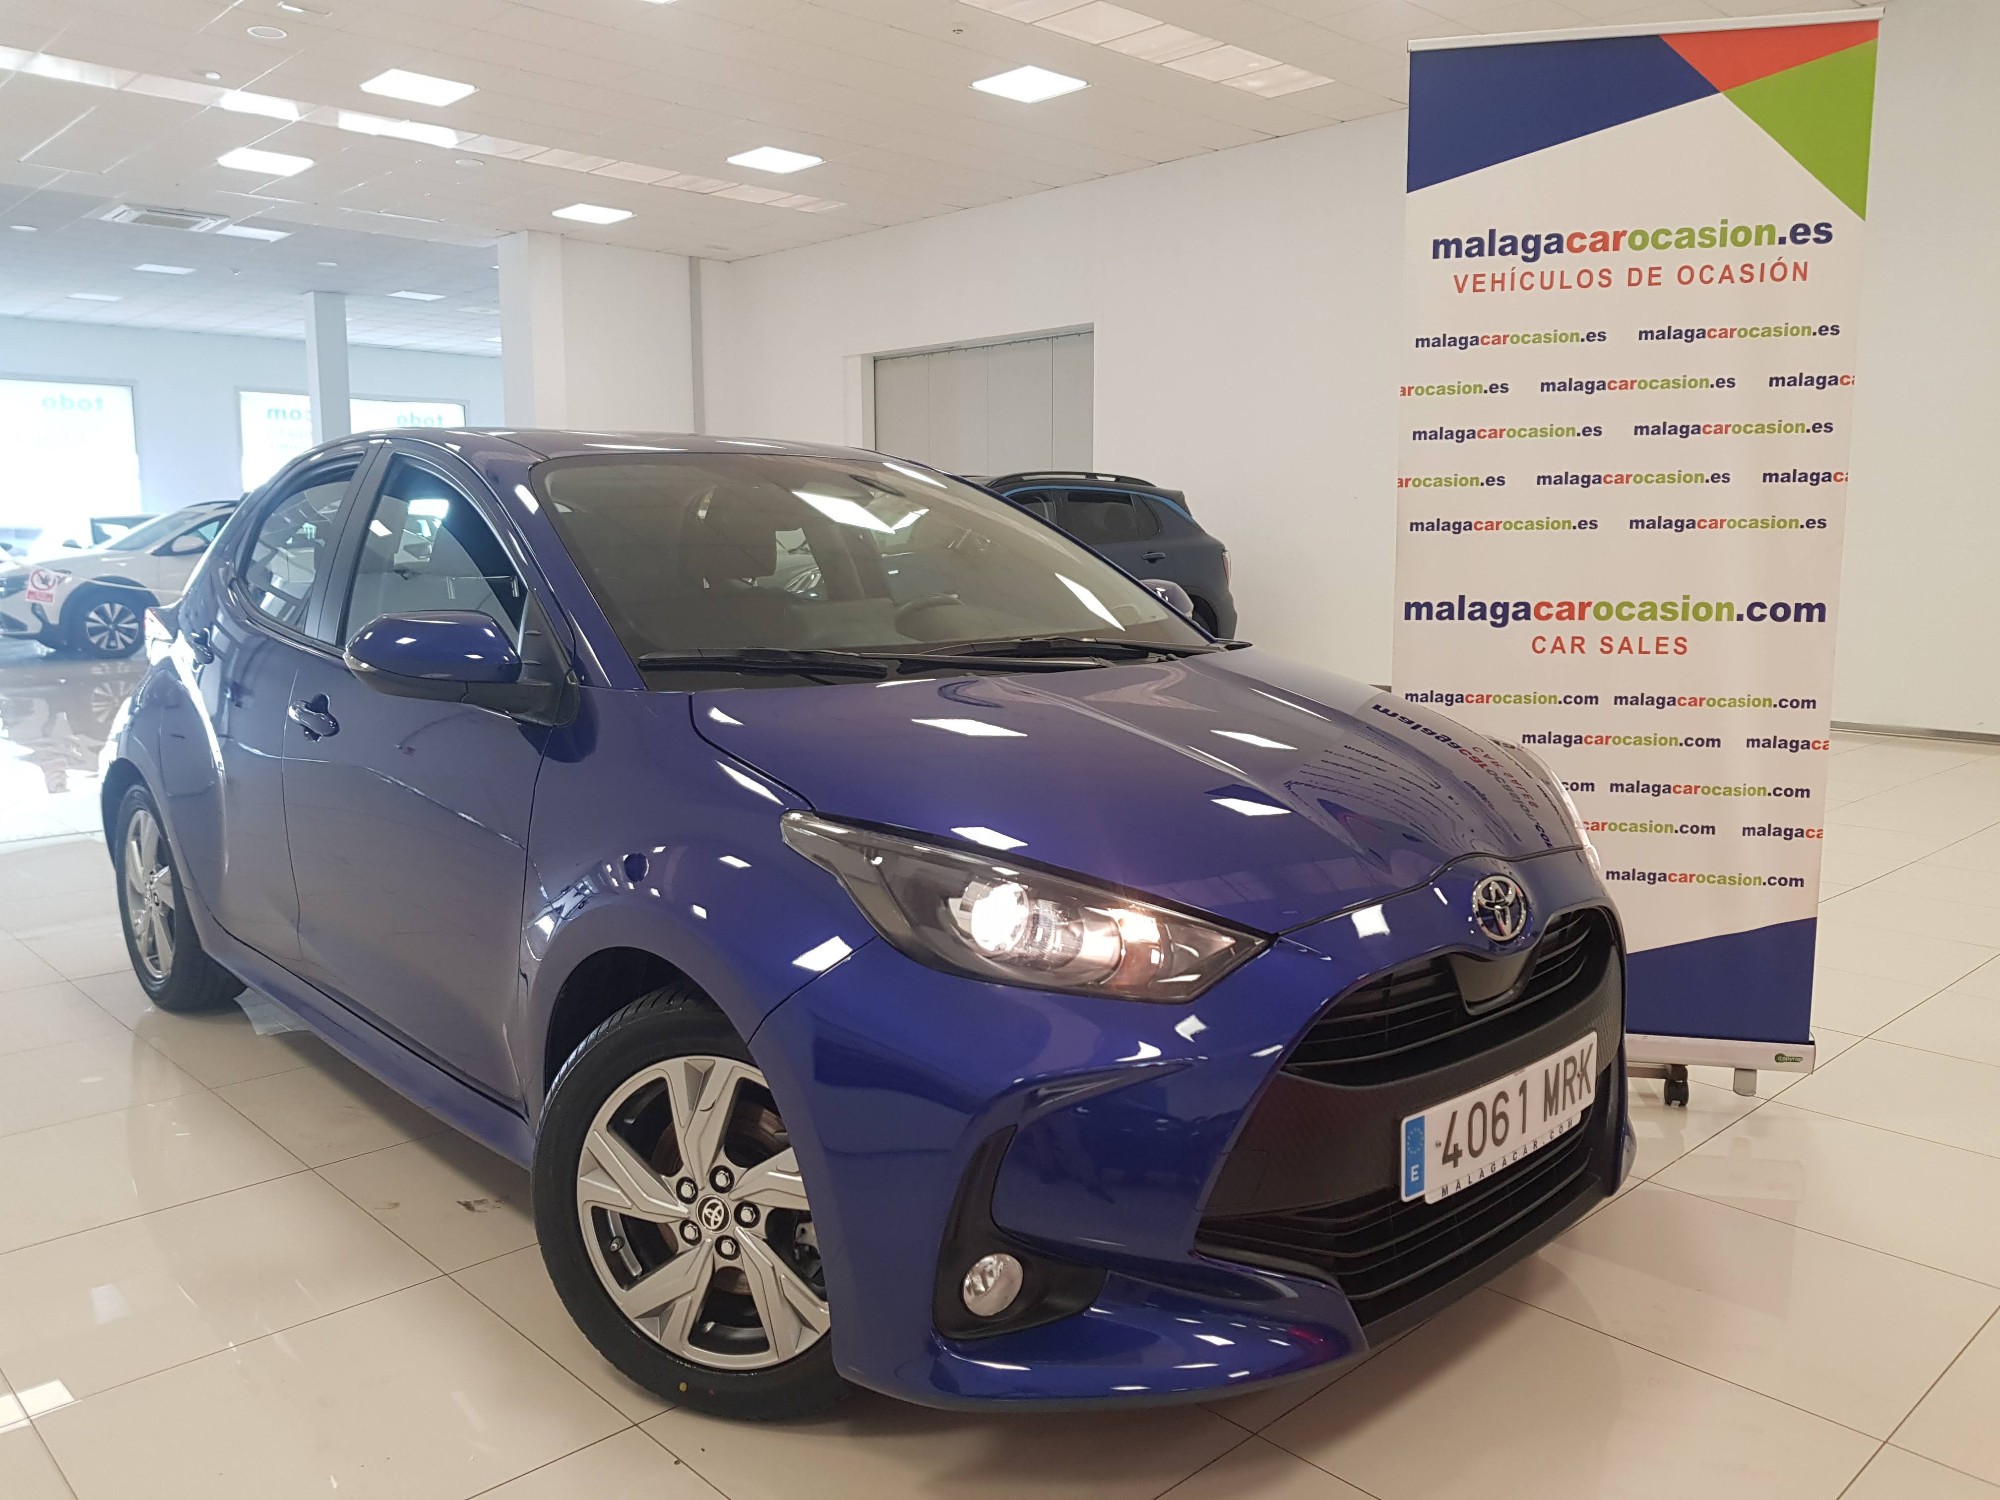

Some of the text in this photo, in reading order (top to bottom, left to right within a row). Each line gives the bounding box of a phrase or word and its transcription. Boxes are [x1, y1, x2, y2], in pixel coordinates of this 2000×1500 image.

[1432, 218, 1834, 263] malagacarocasion.es
[1453, 257, 1809, 294] VEHÍCULOS DE OCASIÓN
[1415, 329, 1607, 350] malagacarocasion.es
[1638, 322, 1841, 343] malagacarocasion.es
[1540, 375, 1737, 395] malagacarocasion.es
[1412, 423, 1603, 444] malagacarocasion.es
[1633, 419, 1834, 439] malagacarocasion.es
[1536, 469, 1731, 489] malagacarocasion.es
[1762, 468, 1848, 487] malagac
[1409, 516, 1599, 535] malagacarocasion.es
[1629, 515, 1828, 533] malagacarocasion.es
[1403, 594, 1827, 629] malagacarocasion.com
[1531, 635, 1688, 656] CAR SALES
[1404, 689, 1600, 708] malagacarocasion.com
[1613, 692, 1817, 711] malagacarocasion.com
[1521, 731, 1722, 749] malagacarocasion.com
[1609, 779, 1811, 800] malagacarocasion.com
[1605, 867, 1805, 888] malagacarocasion.com
[1441, 1042, 1594, 1169] 4061 MRK
[1410, 1164, 1419, 1182] E
